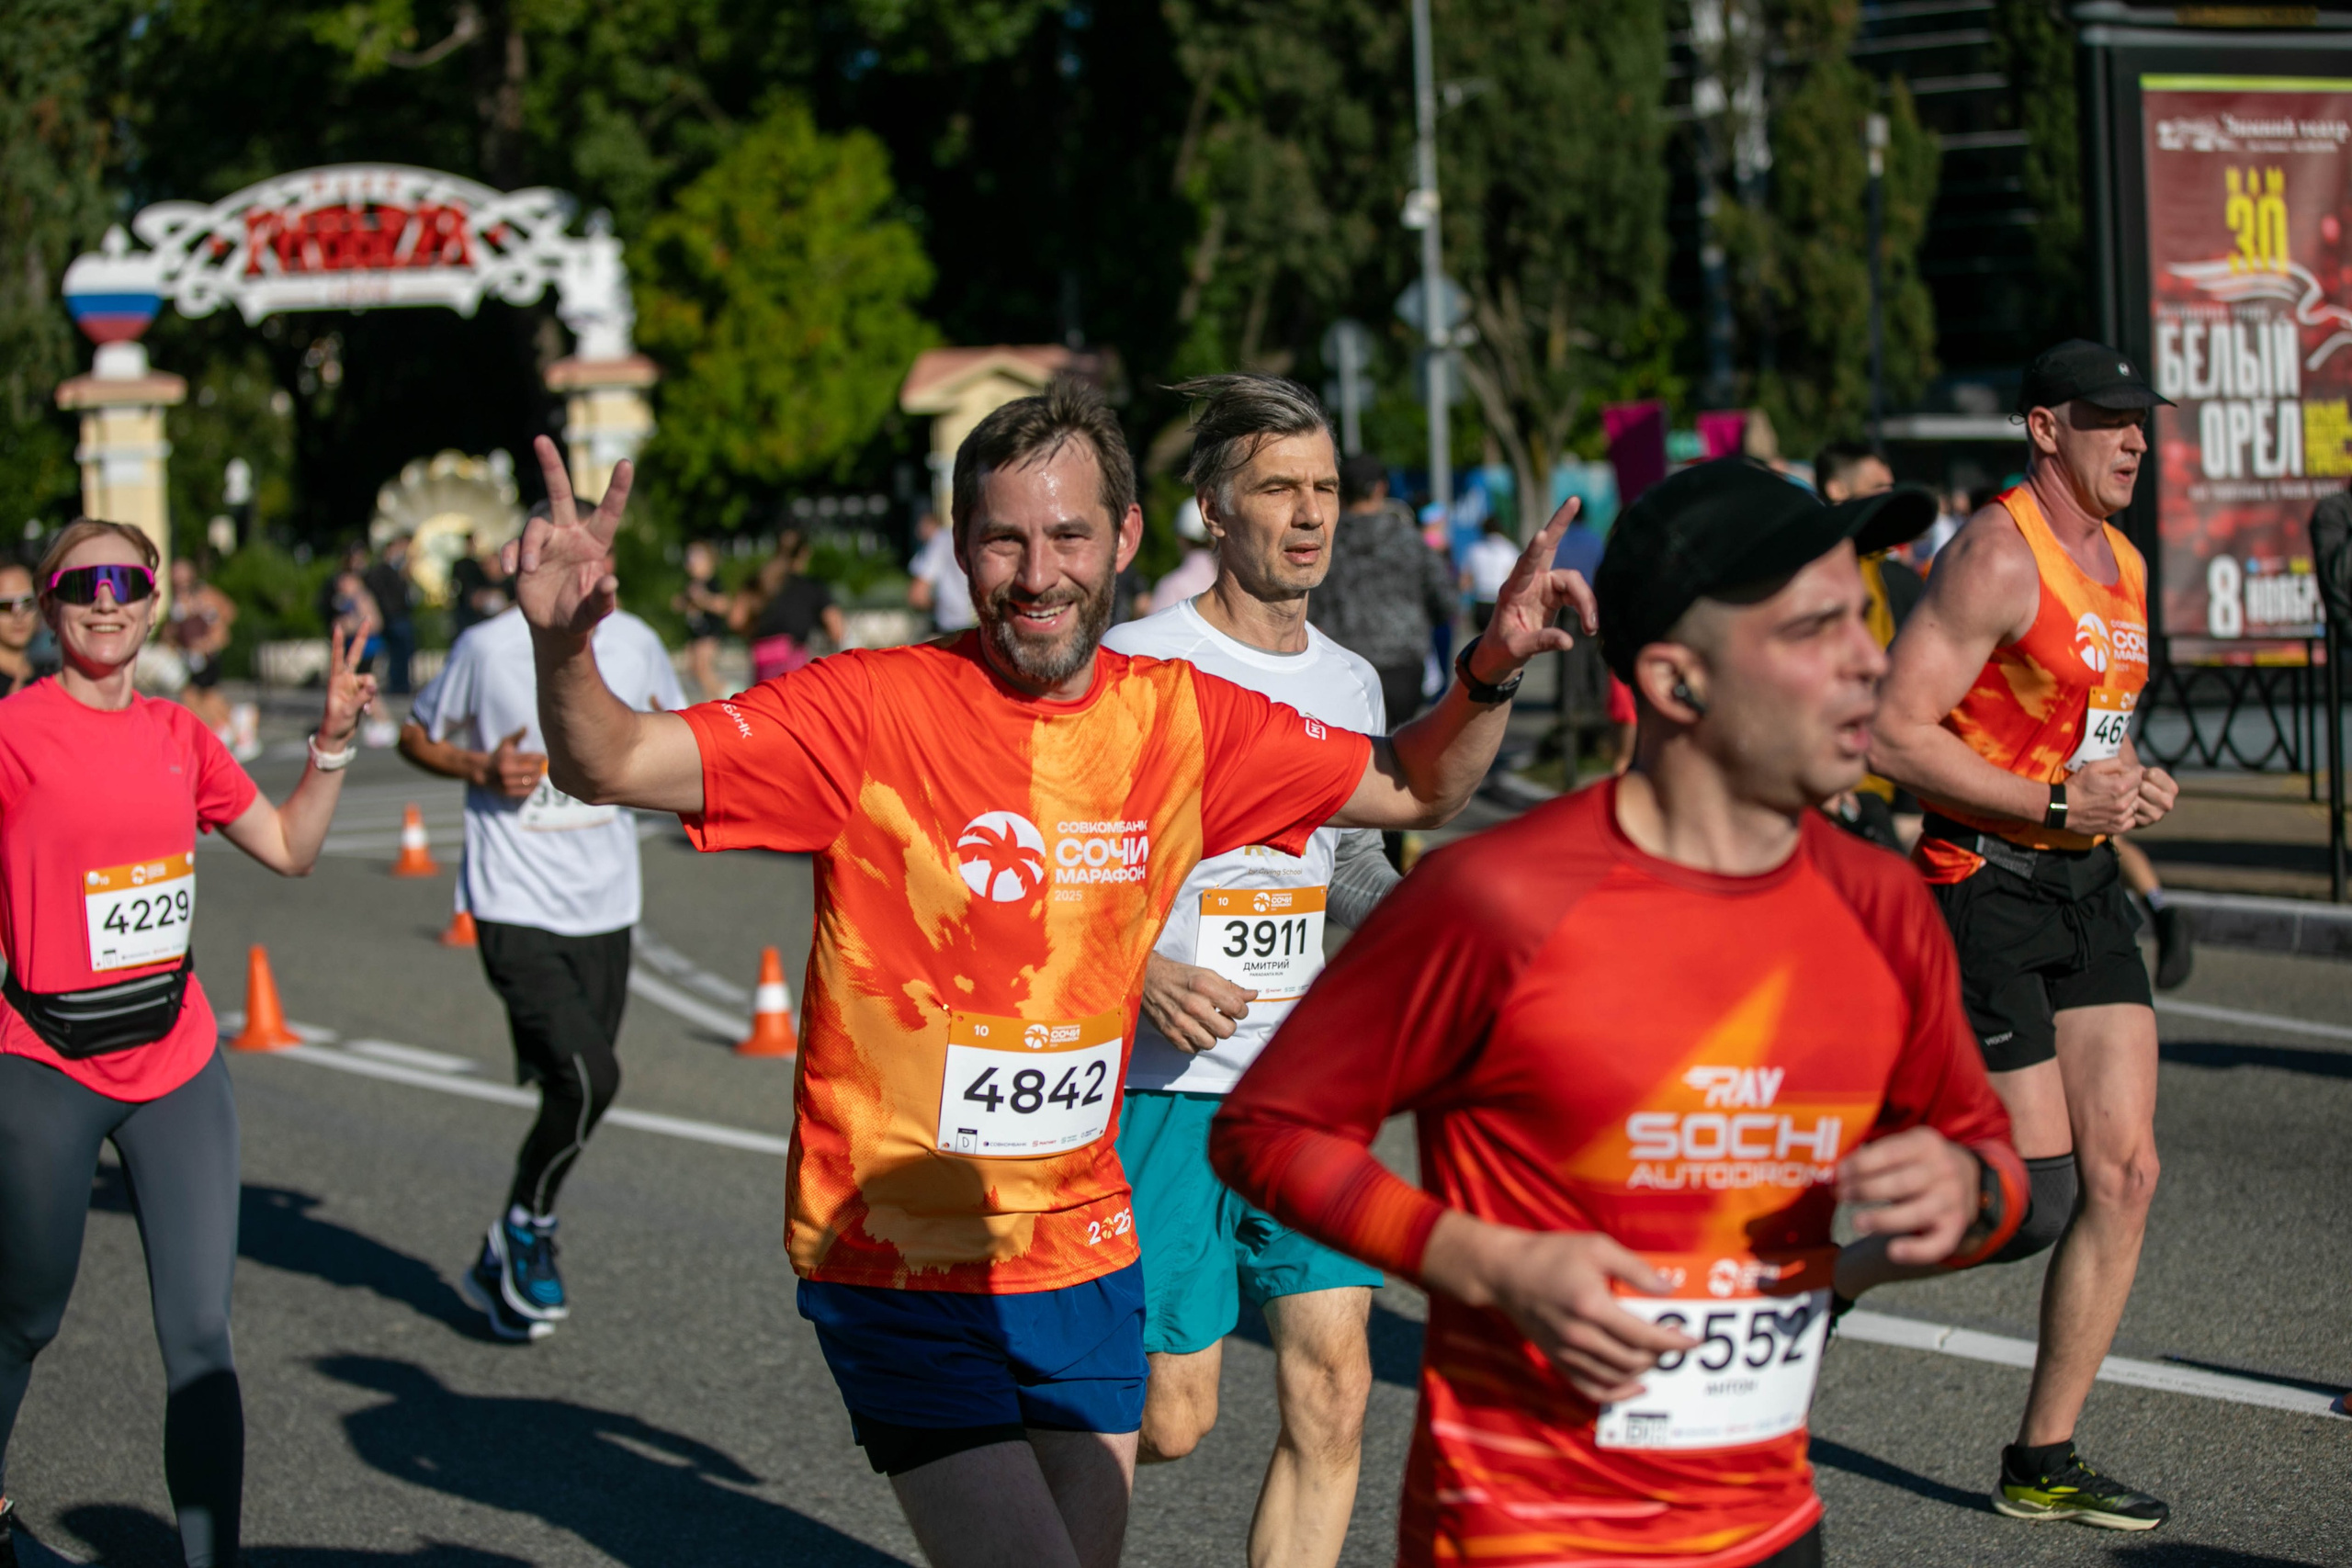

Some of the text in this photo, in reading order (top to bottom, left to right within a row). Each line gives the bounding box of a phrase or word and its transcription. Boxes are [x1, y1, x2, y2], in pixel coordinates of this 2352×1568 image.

[2226, 194, 2289, 274] 30
[2157, 312, 2301, 399] БЕЛЫЙ
[2208, 554, 2243, 637] 8
[721, 703, 752, 739] БАНК
[1057, 819, 1148, 834] СОВКОМБАНК
[1056, 836, 1149, 867] СОЧИ
[1056, 865, 1146, 885] МАРАФОН
[103, 889, 188, 935] 4229
[1055, 889, 1082, 902] 2025
[1217, 897, 1228, 907] 10
[1222, 919, 1306, 958] 3911
[1243, 958, 1290, 972] ДМИТРИЙ
[974, 1024, 989, 1037] 10
[1050, 1028, 1080, 1039] СОЧИ
[964, 1059, 1107, 1114] 4842
[1625, 1111, 1842, 1162] SOCHI
